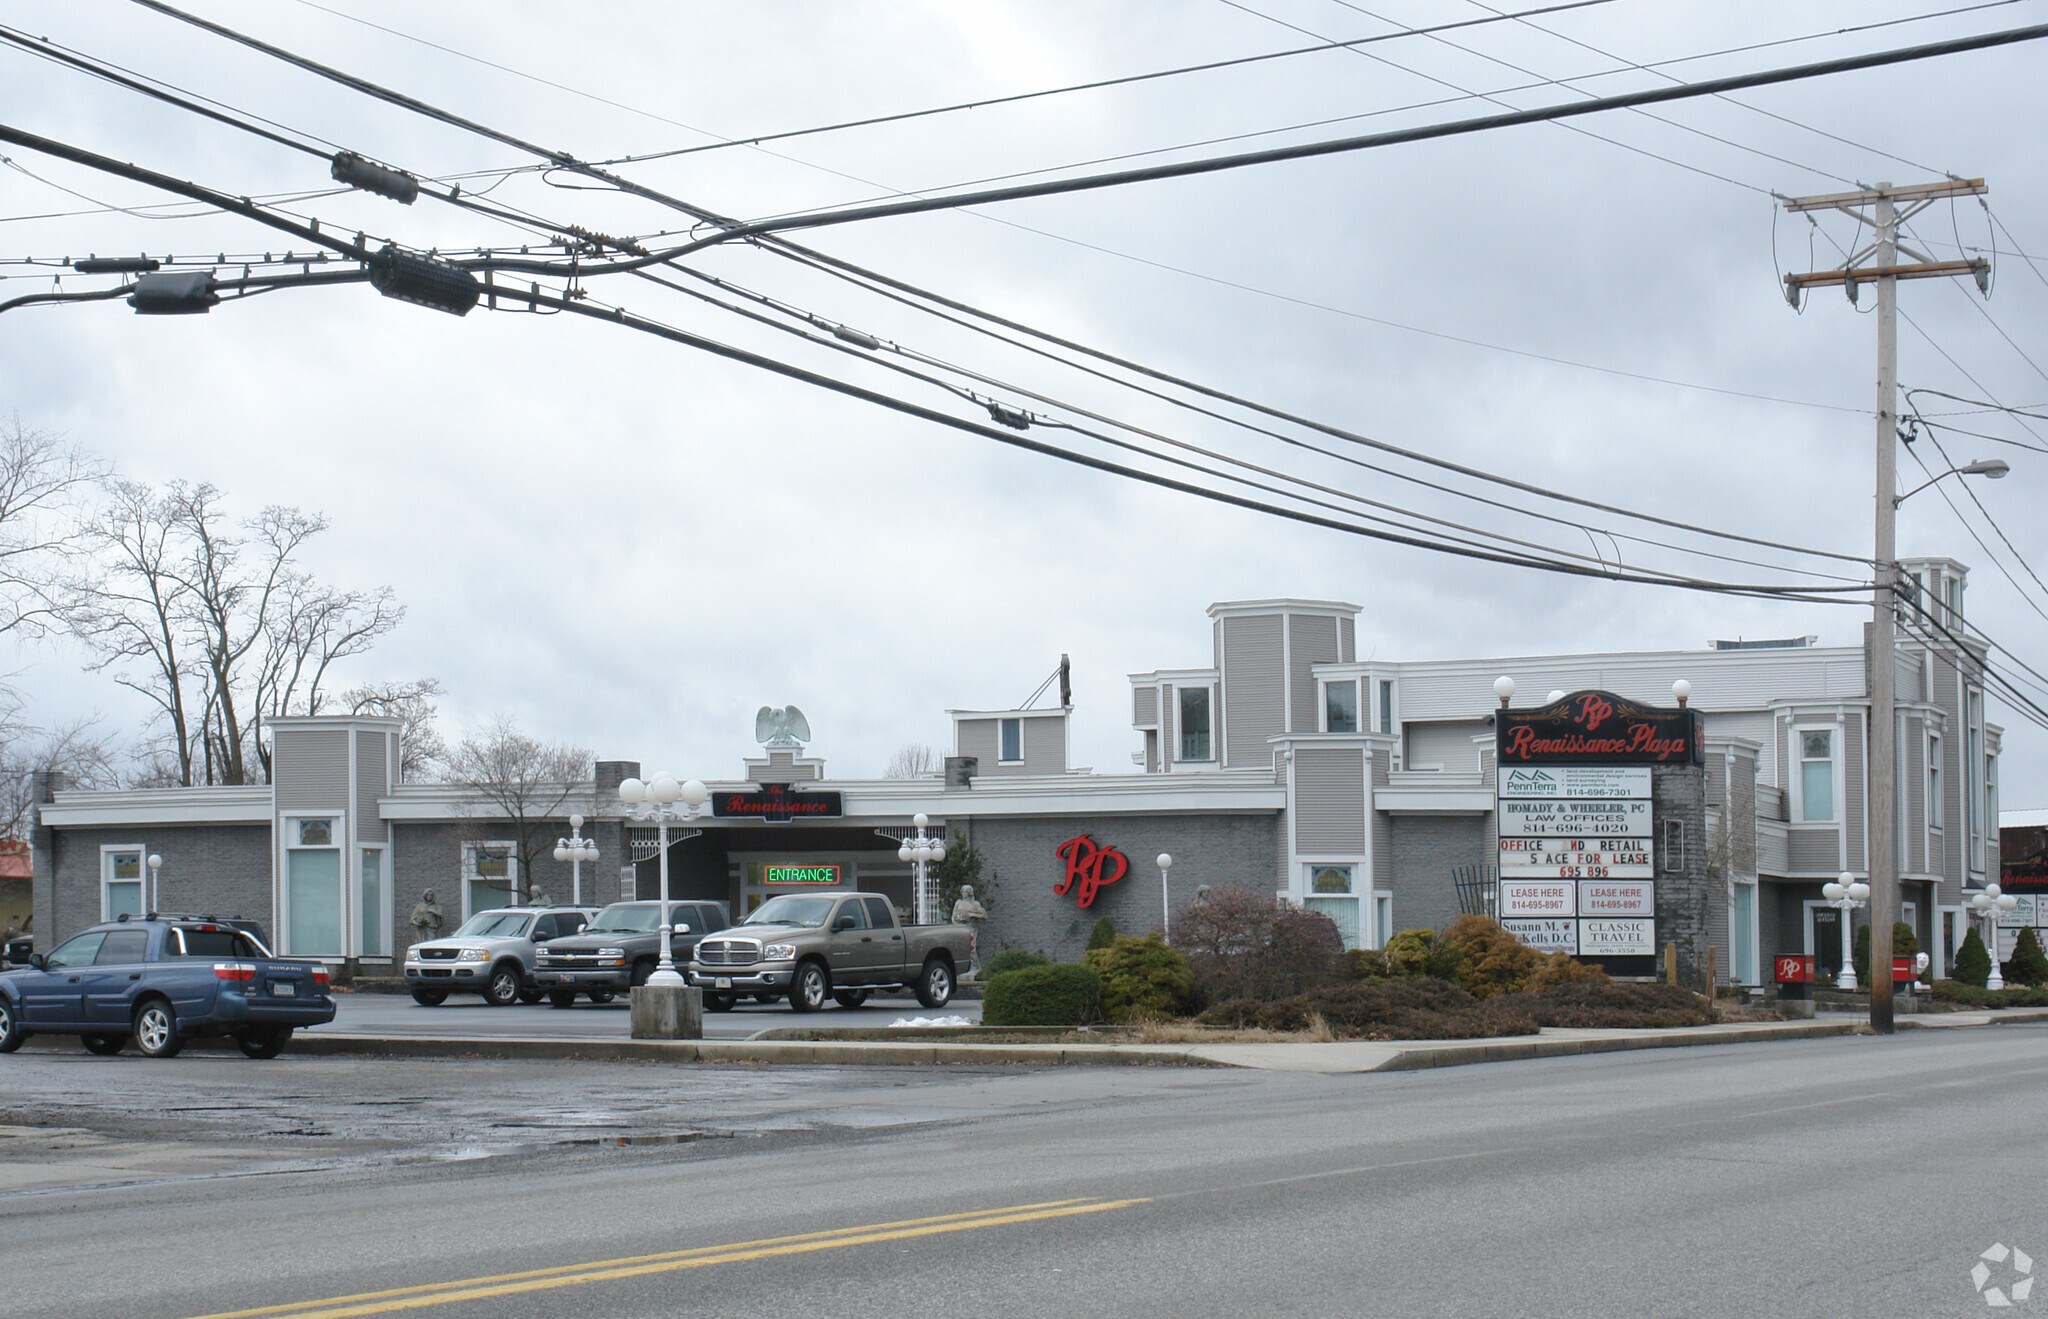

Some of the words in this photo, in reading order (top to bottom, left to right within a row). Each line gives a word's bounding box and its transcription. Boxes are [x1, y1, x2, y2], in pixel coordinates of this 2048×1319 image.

[1506, 725, 1626, 760] Renaissance
[1625, 723, 1685, 760] Plaza
[1507, 781, 1557, 791] PennTerra
[726, 794, 828, 813] Renaissance
[1507, 804, 1554, 813] HOMADY
[1556, 804, 1566, 813] &
[1569, 804, 1628, 814] WHEELER,
[1631, 804, 1645, 813] PC
[1523, 824, 1629, 833] 814-696-4020
[1500, 840, 1543, 851] OFFICE
[1600, 840, 1644, 851] RETAIL
[1577, 853, 1601, 864] FOR
[1613, 853, 1649, 864] LEASE
[769, 868, 833, 881] ENTRANCE
[1560, 866, 1581, 877] 695
[1587, 866, 1609, 877] 896
[1510, 889, 1539, 897] LEASE
[1540, 889, 1564, 897] HERE
[1590, 889, 1617, 897] LEASE
[1619, 889, 1642, 897] HERE
[1511, 901, 1564, 909] 814-695-8967
[1591, 901, 1642, 909] 814-695-8967
[1503, 921, 1541, 932] Susann
[1544, 921, 1559, 931] M.
[1588, 922, 1646, 932] CLASSIC
[1551, 933, 1575, 943] D.C.
[1590, 933, 1644, 942] TRAVEL
